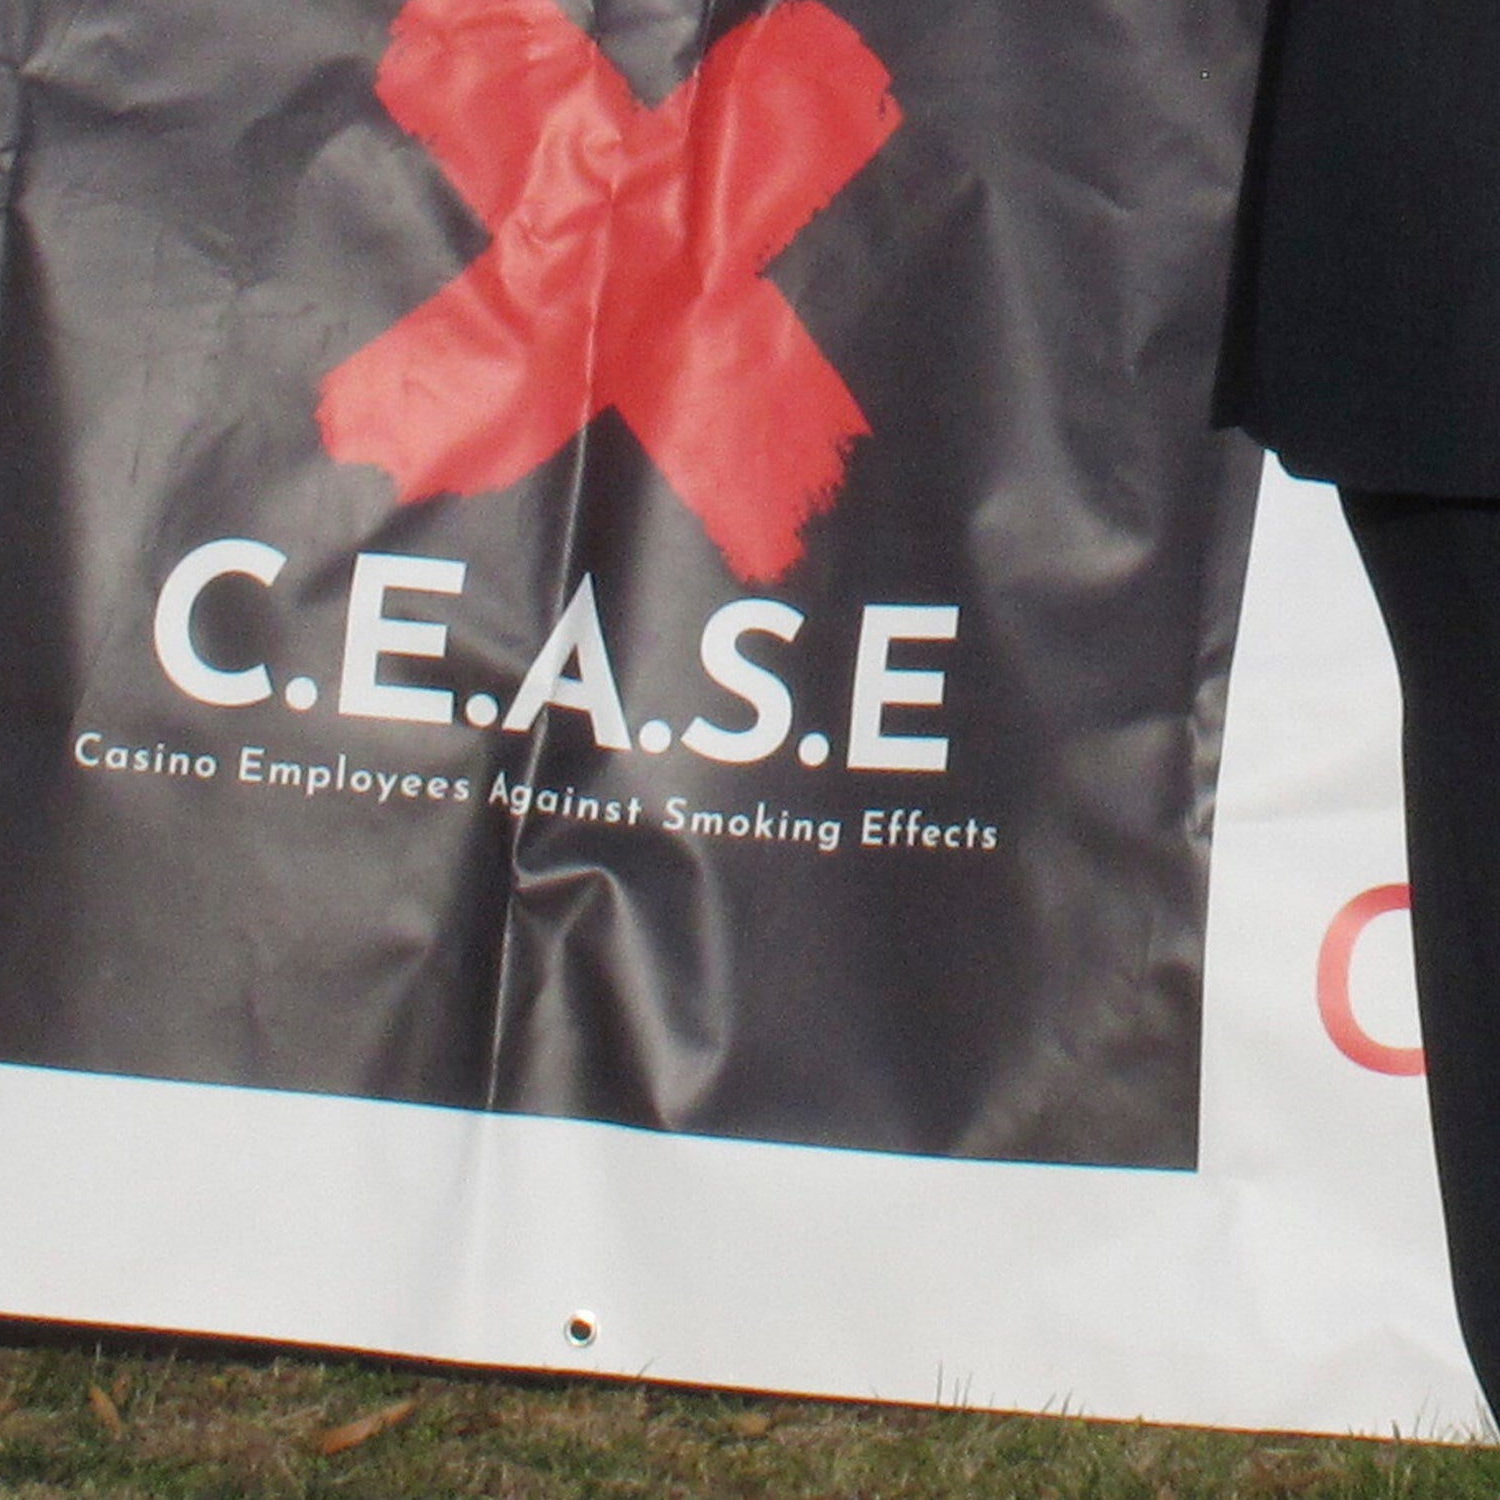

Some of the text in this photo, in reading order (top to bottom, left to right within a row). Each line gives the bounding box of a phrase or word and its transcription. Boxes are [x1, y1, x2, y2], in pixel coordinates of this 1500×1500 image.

[153, 537, 961, 774] C.E.A.S.E
[73, 731, 999, 853] Casino Employees Against Smoking Effects
